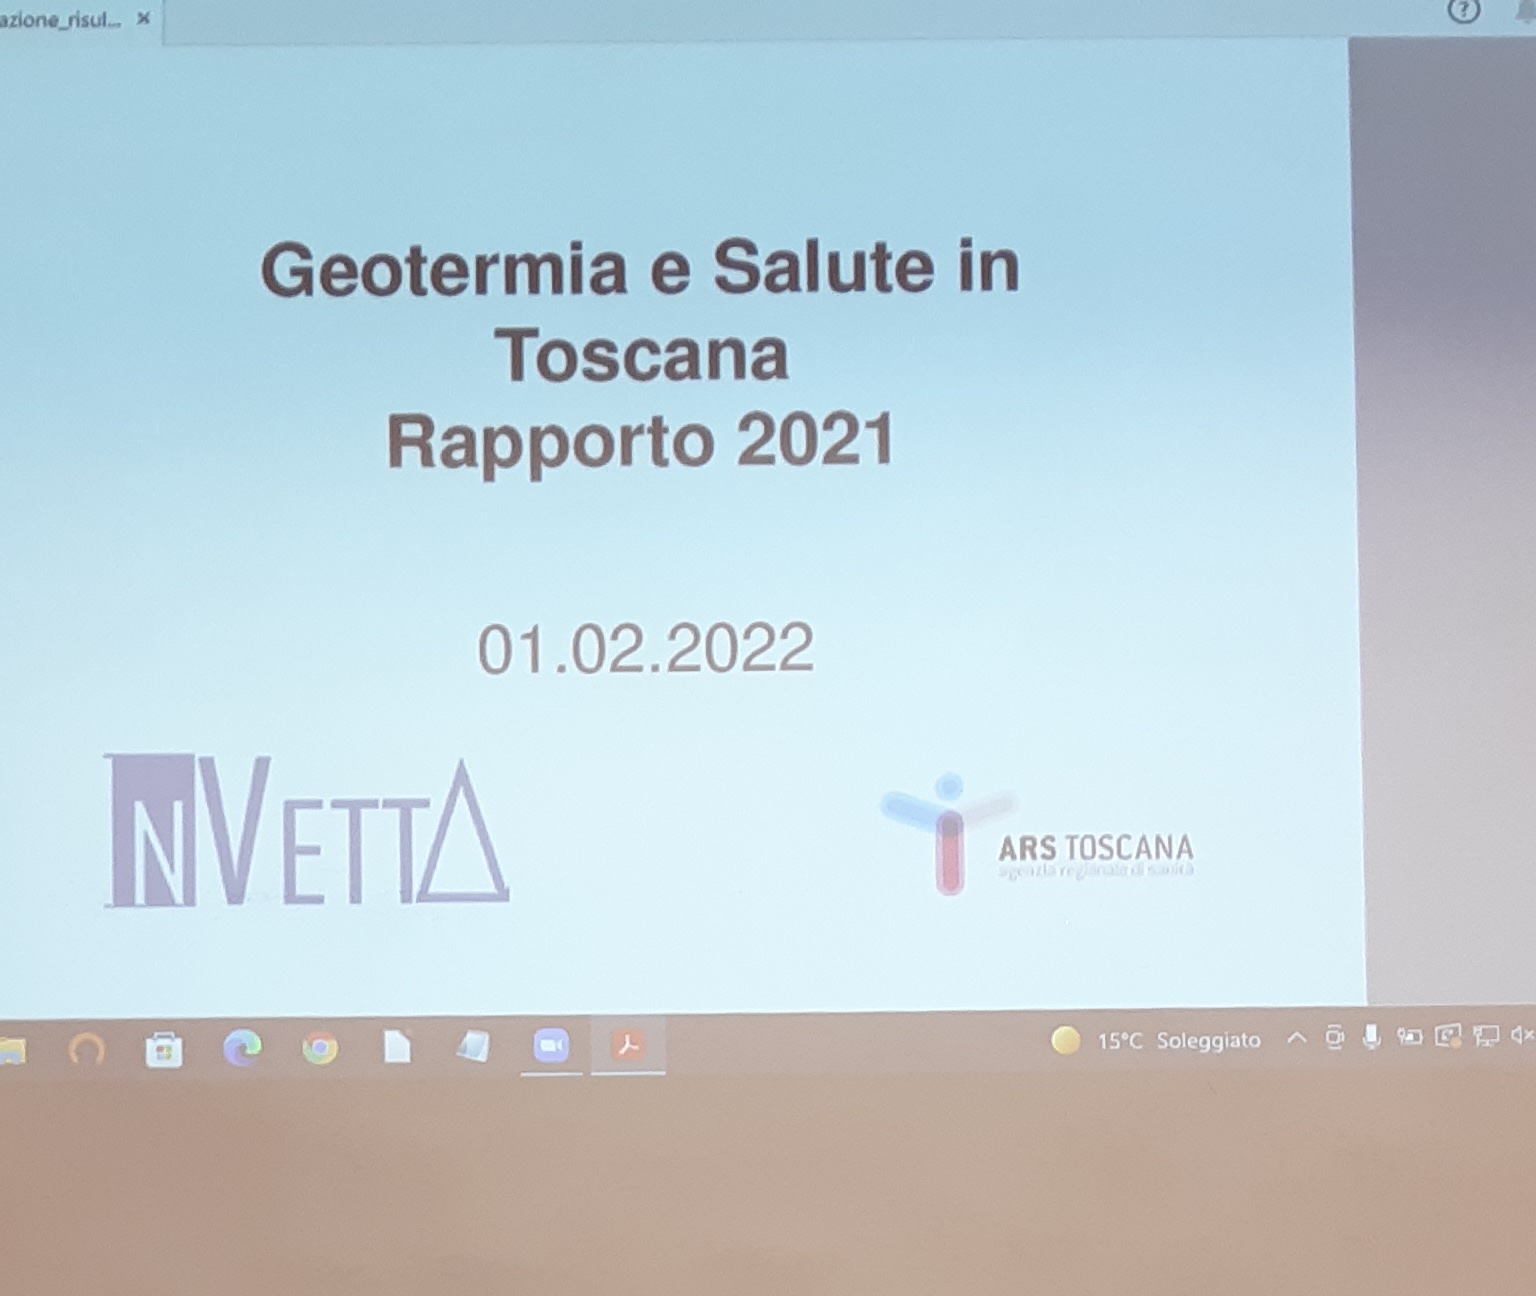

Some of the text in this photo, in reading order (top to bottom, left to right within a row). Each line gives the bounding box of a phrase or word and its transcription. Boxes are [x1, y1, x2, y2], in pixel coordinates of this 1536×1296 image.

[261, 236, 1020, 298] Geotermia e Salute in
[493, 326, 789, 383] Toscana
[388, 409, 892, 483] Rapporto 2021
[478, 621, 815, 676] 01.02.2022
[998, 833, 1194, 862] ARS TOSCANA
[1098, 1031, 1262, 1054] 15°C Soleggiato
